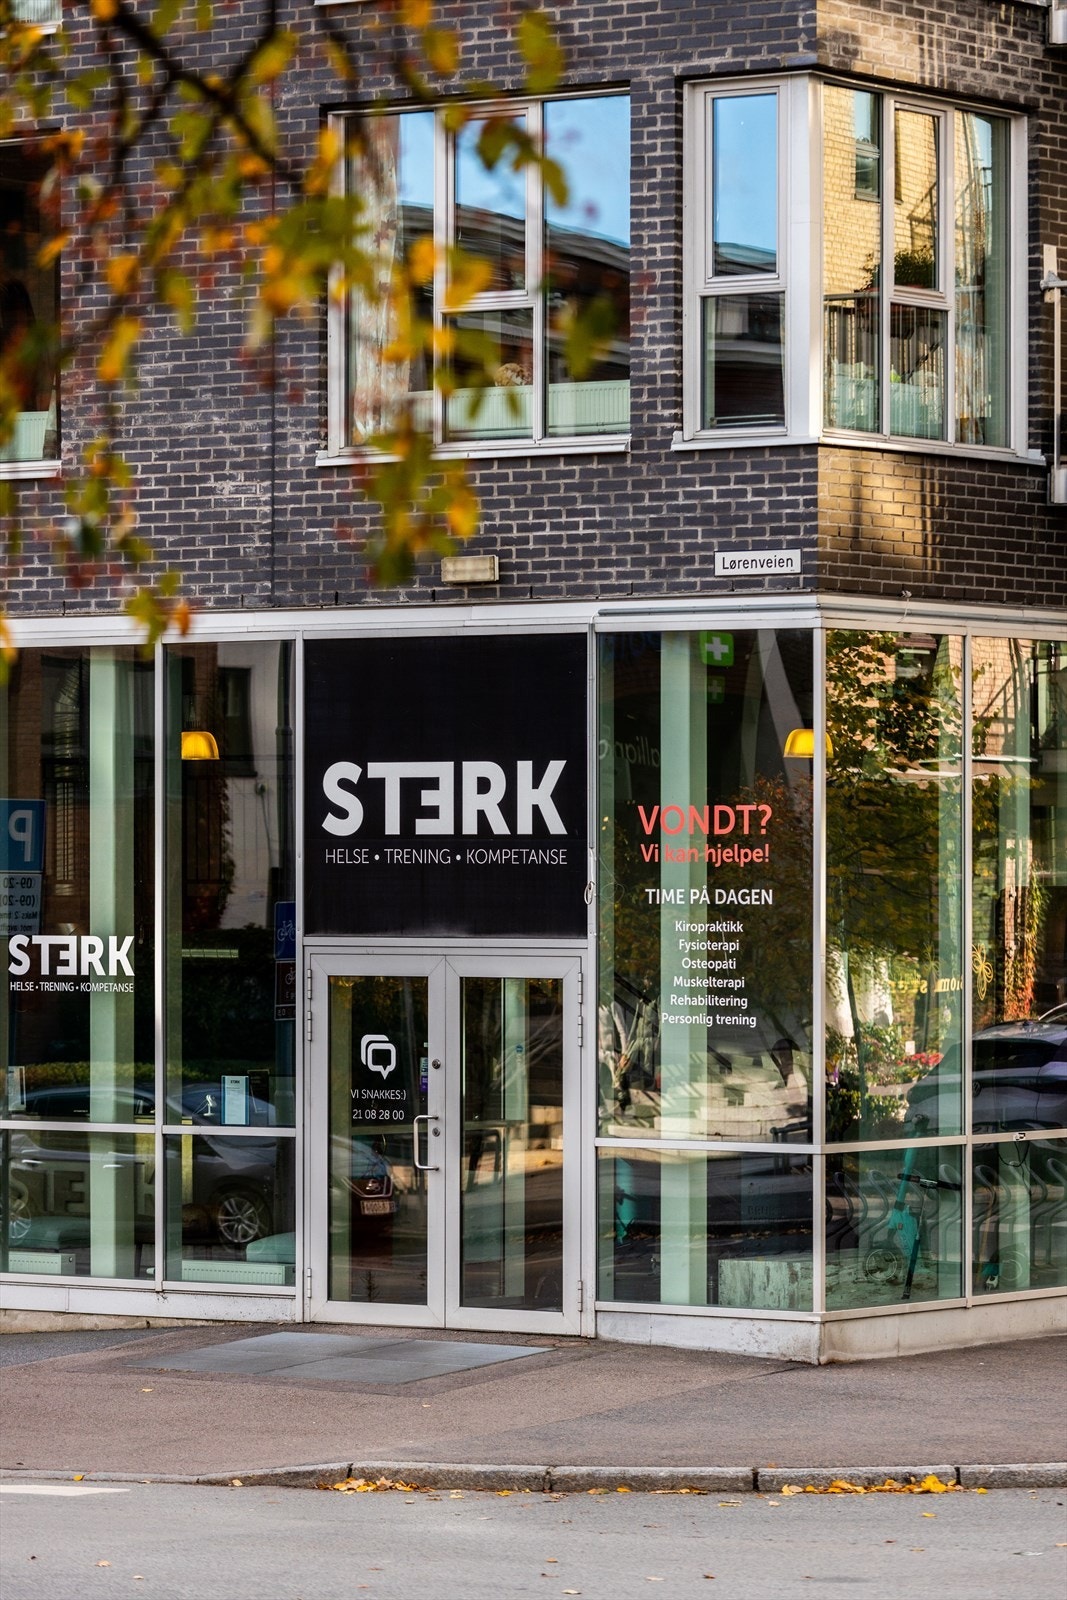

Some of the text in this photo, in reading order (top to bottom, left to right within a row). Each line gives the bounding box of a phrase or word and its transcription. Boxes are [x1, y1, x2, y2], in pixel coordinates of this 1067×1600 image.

[722, 555, 793, 570] Lørenveien
[321, 760, 568, 836] STERK
[637, 804, 773, 835] VONDT?
[325, 848, 568, 865] HELSE TRENING KOMPETANSE
[640, 843, 770, 868] Vi kan hjelpe!
[645, 884, 773, 905] TIME PÅ DAGEN
[675, 920, 744, 934] Kiropraktikk
[679, 939, 740, 953] Fysioterapi
[8, 934, 135, 976] STERK
[681, 957, 737, 971] Osteopati
[10, 982, 134, 992] HELSE TRENING KOMPETANSE
[673, 975, 745, 990] Muskelterapi
[670, 994, 748, 1009] Rehabilitering
[661, 1012, 757, 1028] Personlig trening
[350, 1089, 407, 1100] VI SNAKKES:)
[352, 1109, 405, 1120] 21 08 28 00
